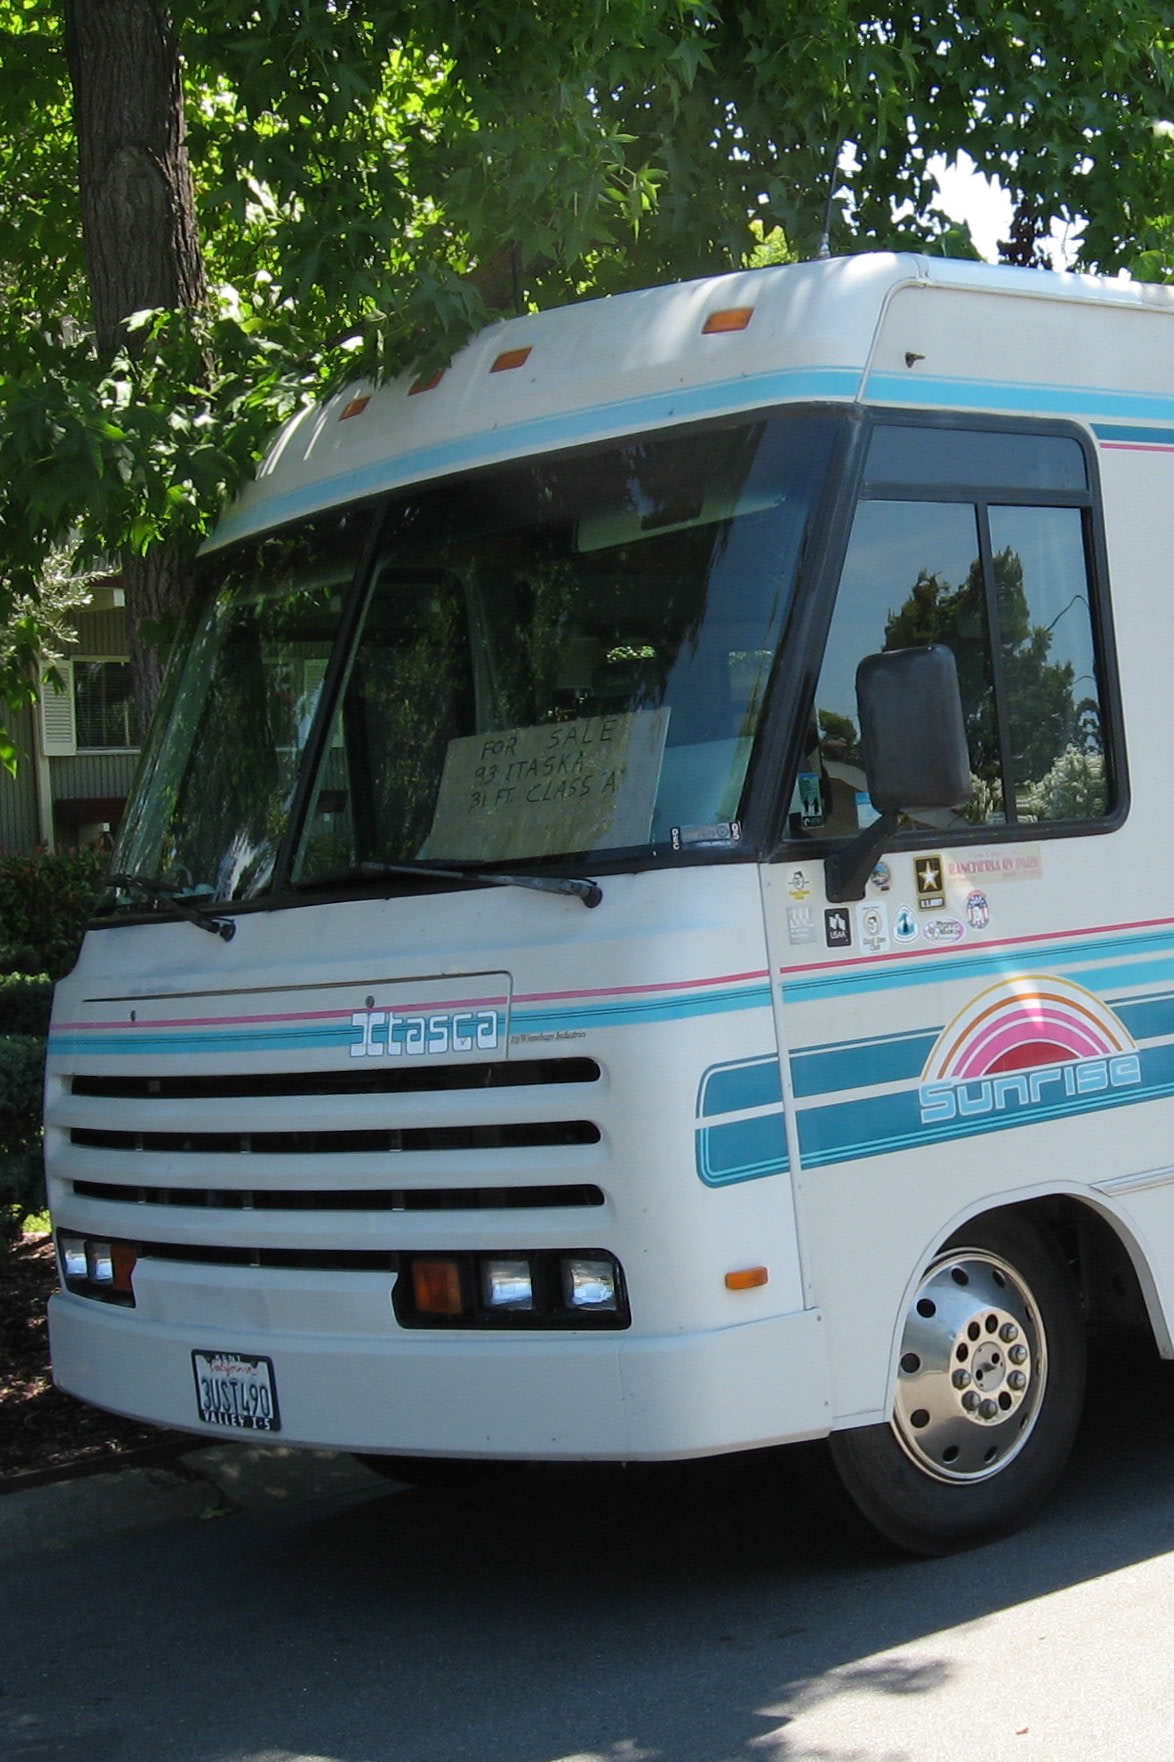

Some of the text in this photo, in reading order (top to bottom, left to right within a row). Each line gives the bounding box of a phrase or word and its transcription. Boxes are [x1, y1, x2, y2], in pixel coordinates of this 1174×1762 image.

[481, 719, 617, 760] FOR SALE
[474, 751, 585, 786] 93 ITASKA
[526, 775, 594, 802] CLASS
[350, 1010, 498, 1058] Itasca
[201, 1378, 270, 1418] 3UST490
[203, 1410, 245, 1427] VALLEY
